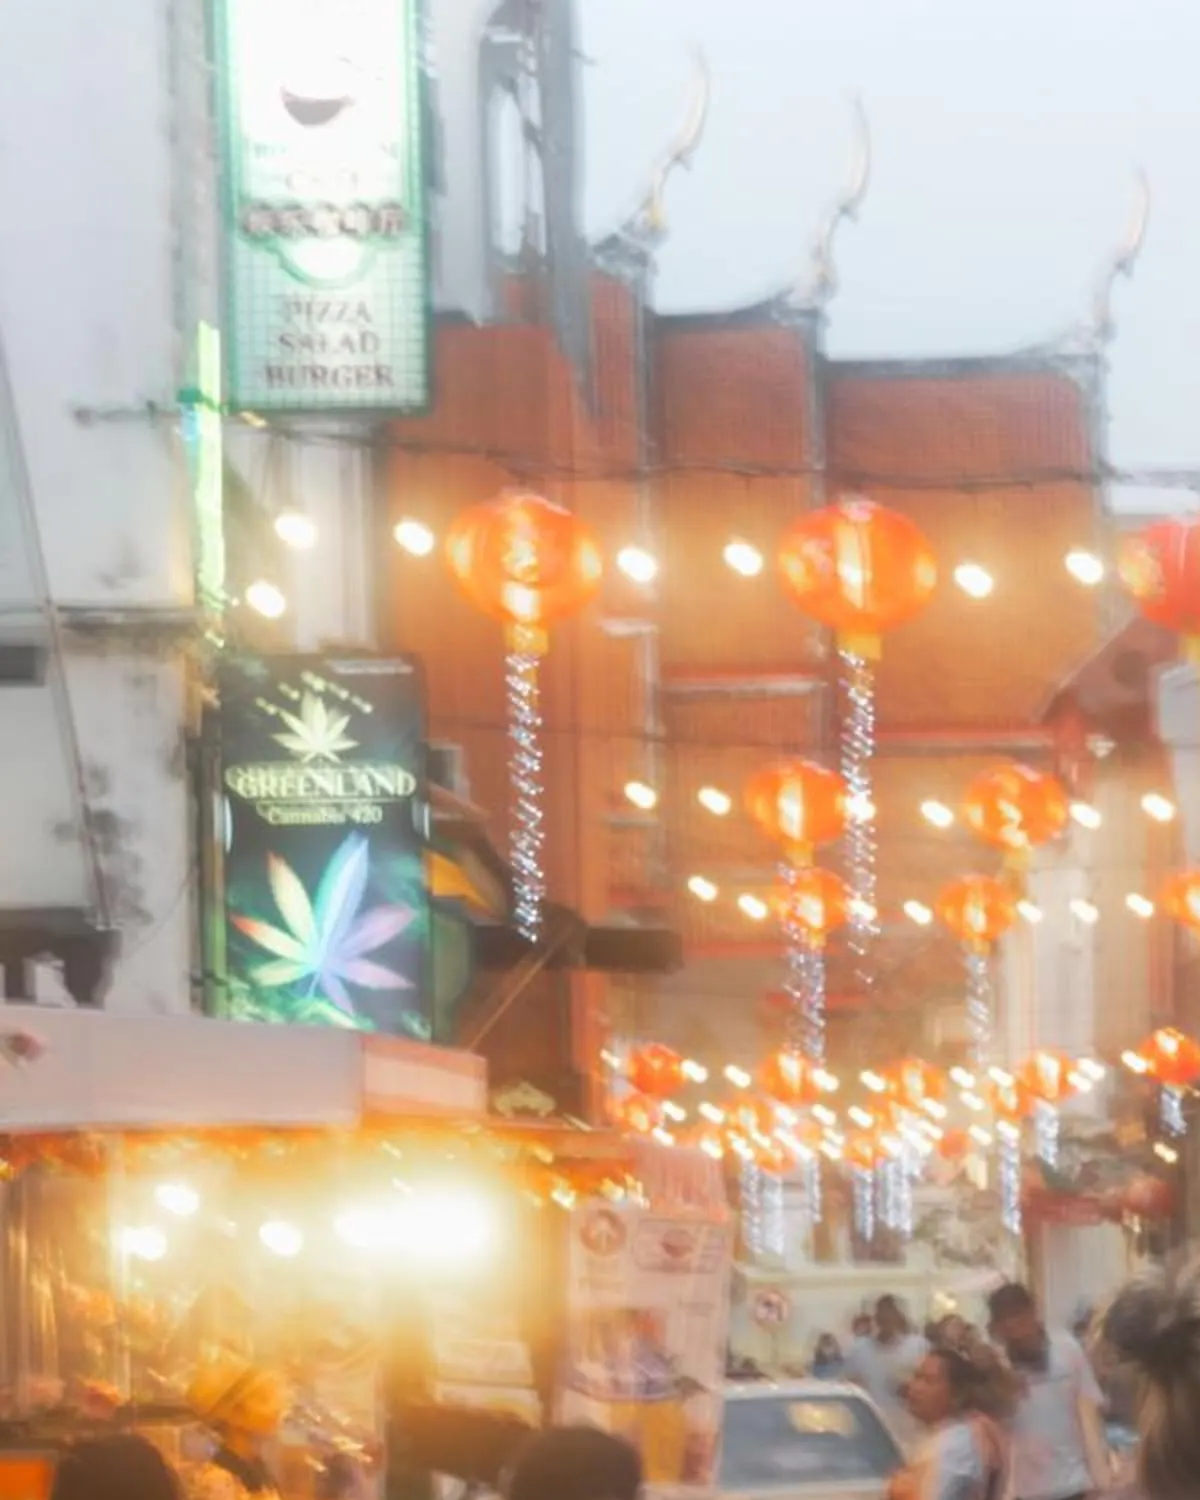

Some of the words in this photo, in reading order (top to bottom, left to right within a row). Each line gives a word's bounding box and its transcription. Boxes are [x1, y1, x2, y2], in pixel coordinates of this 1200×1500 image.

[281, 301, 373, 323] PIZZA
[278, 331, 381, 354] SALAD
[264, 363, 395, 388] BURGER
[232, 766, 417, 798] GREENLAND
[350, 804, 384, 825] 420
